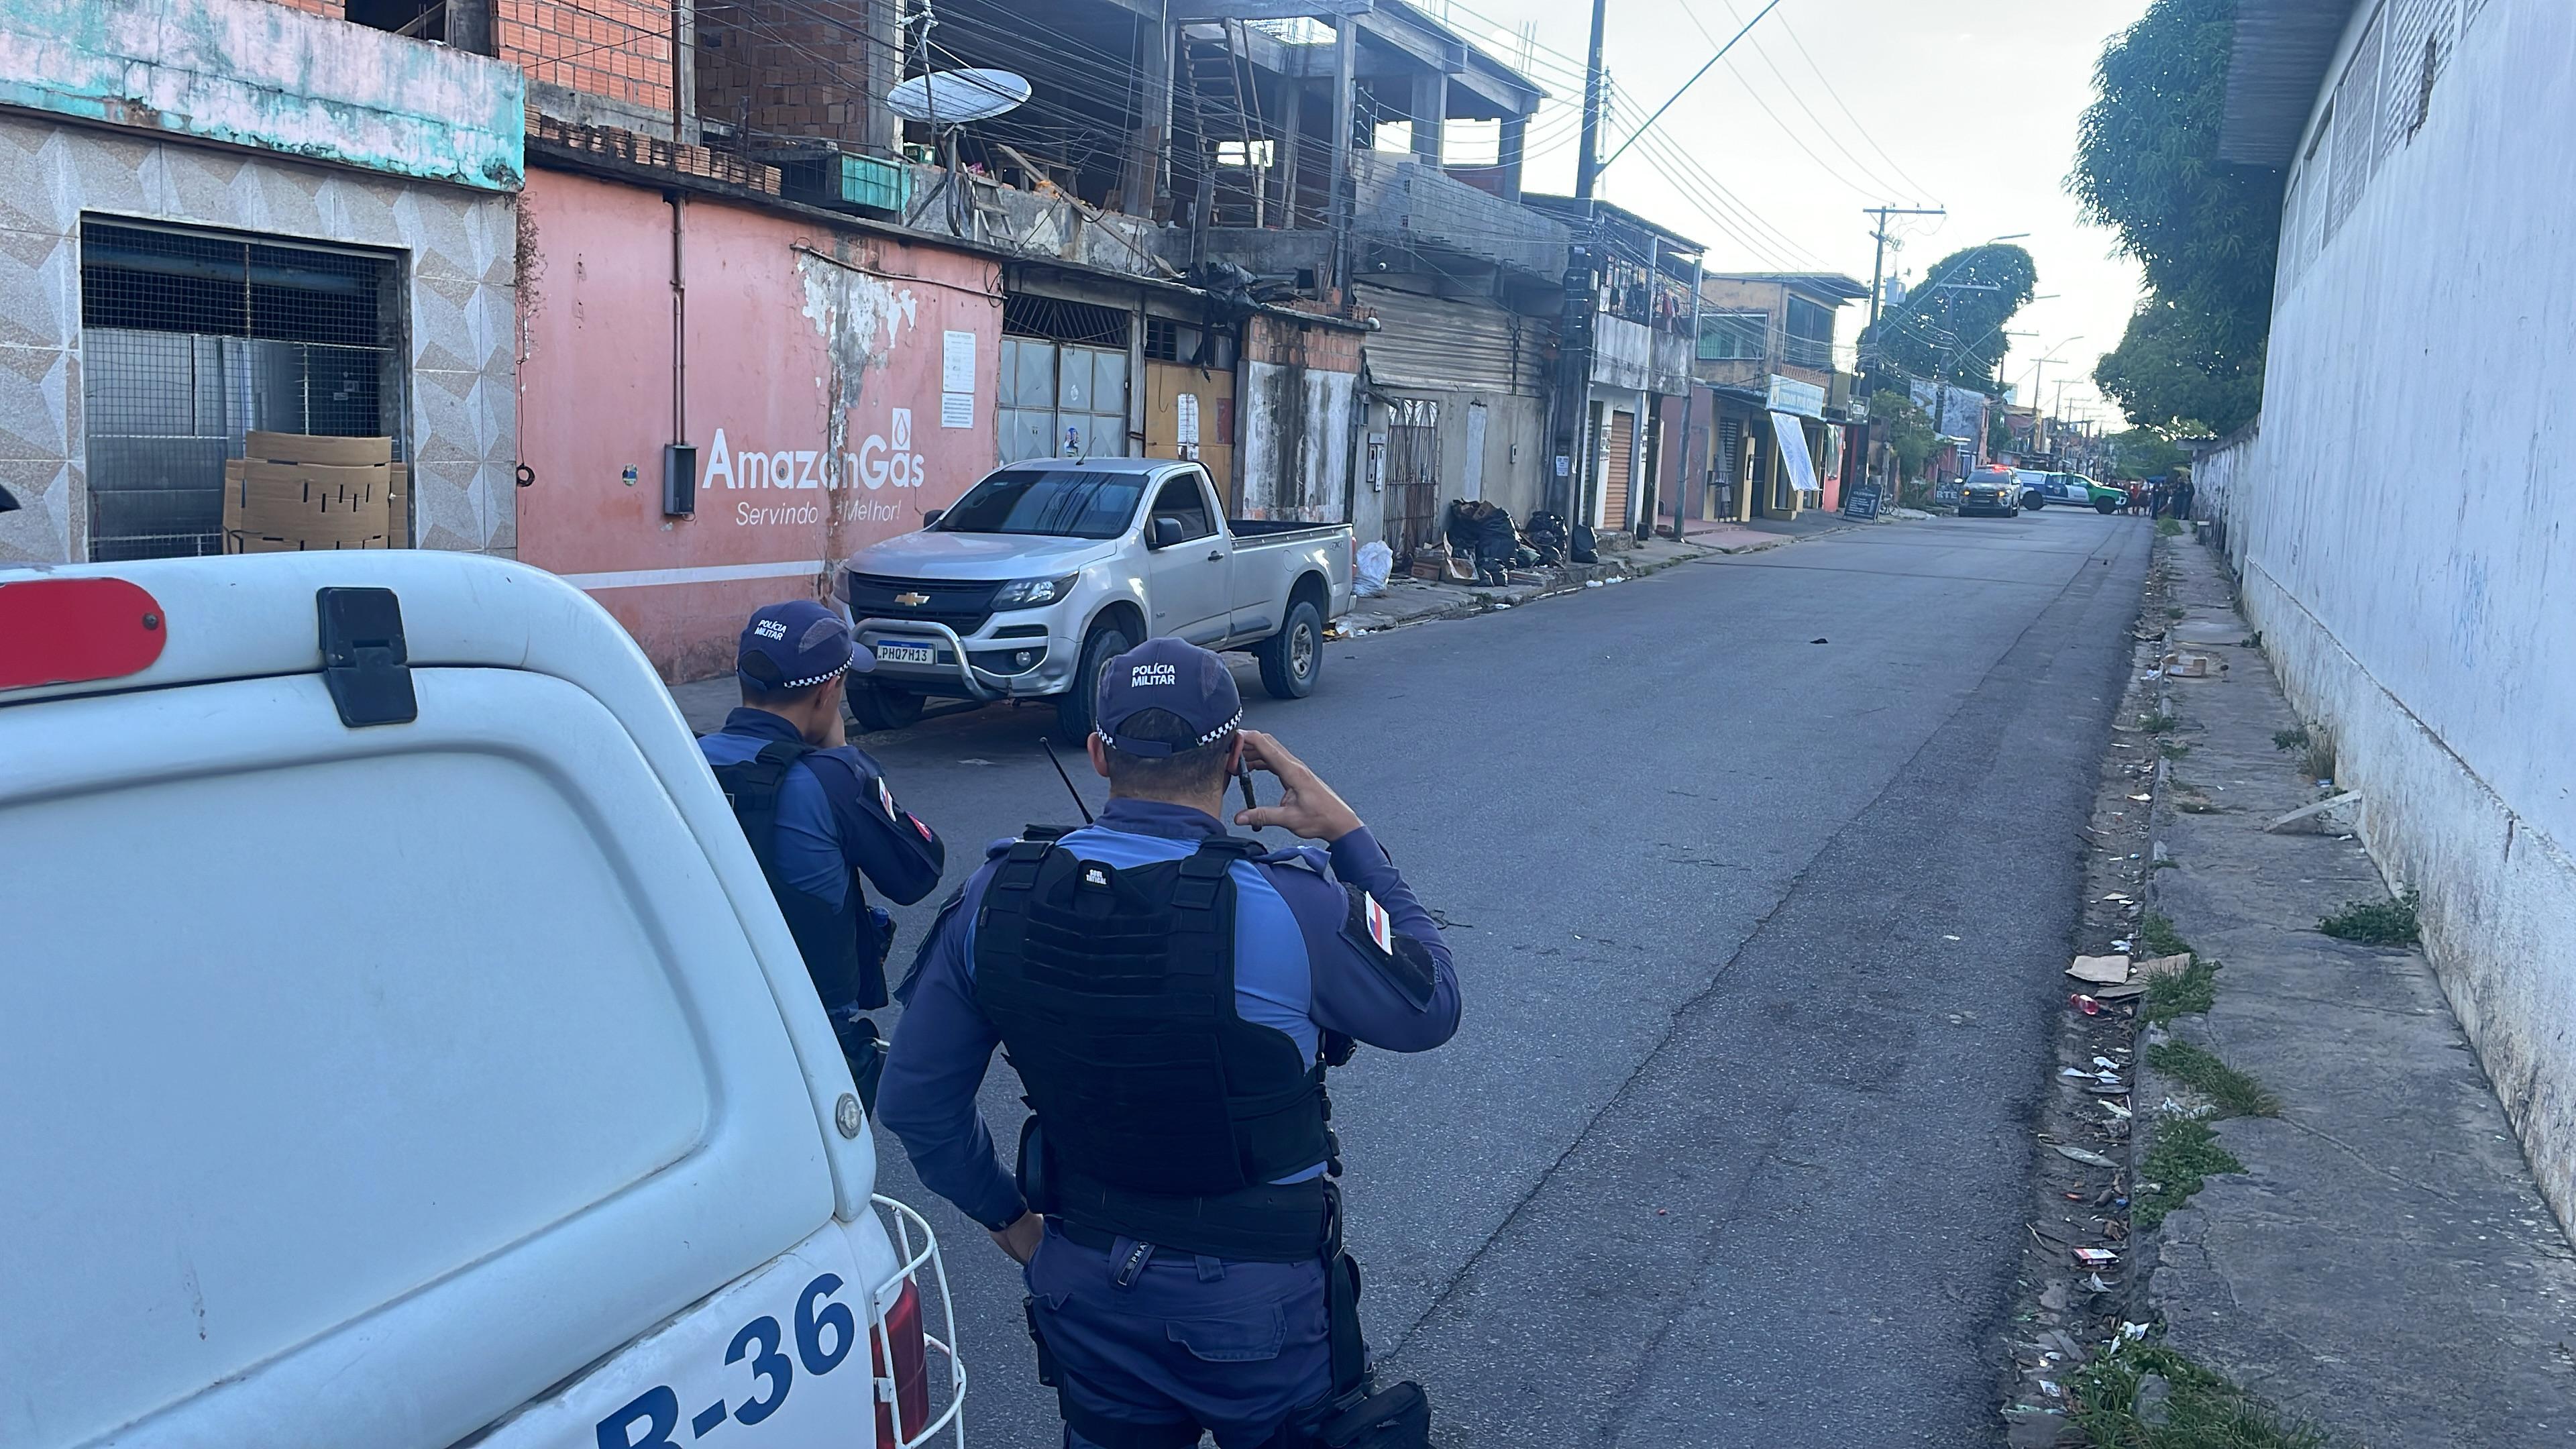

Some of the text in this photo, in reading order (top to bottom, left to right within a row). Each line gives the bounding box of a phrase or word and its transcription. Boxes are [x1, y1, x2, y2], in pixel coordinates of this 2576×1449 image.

[736, 501, 818, 526] Servindo
[843, 500, 902, 522] Melhor!
[758, 619, 787, 633] POLÍCIA
[754, 627, 784, 641] MILITAR
[882, 647, 927, 661] PHQ7H13
[1132, 662, 1175, 676] POLÍCIA
[1131, 674, 1175, 688] MILITAR
